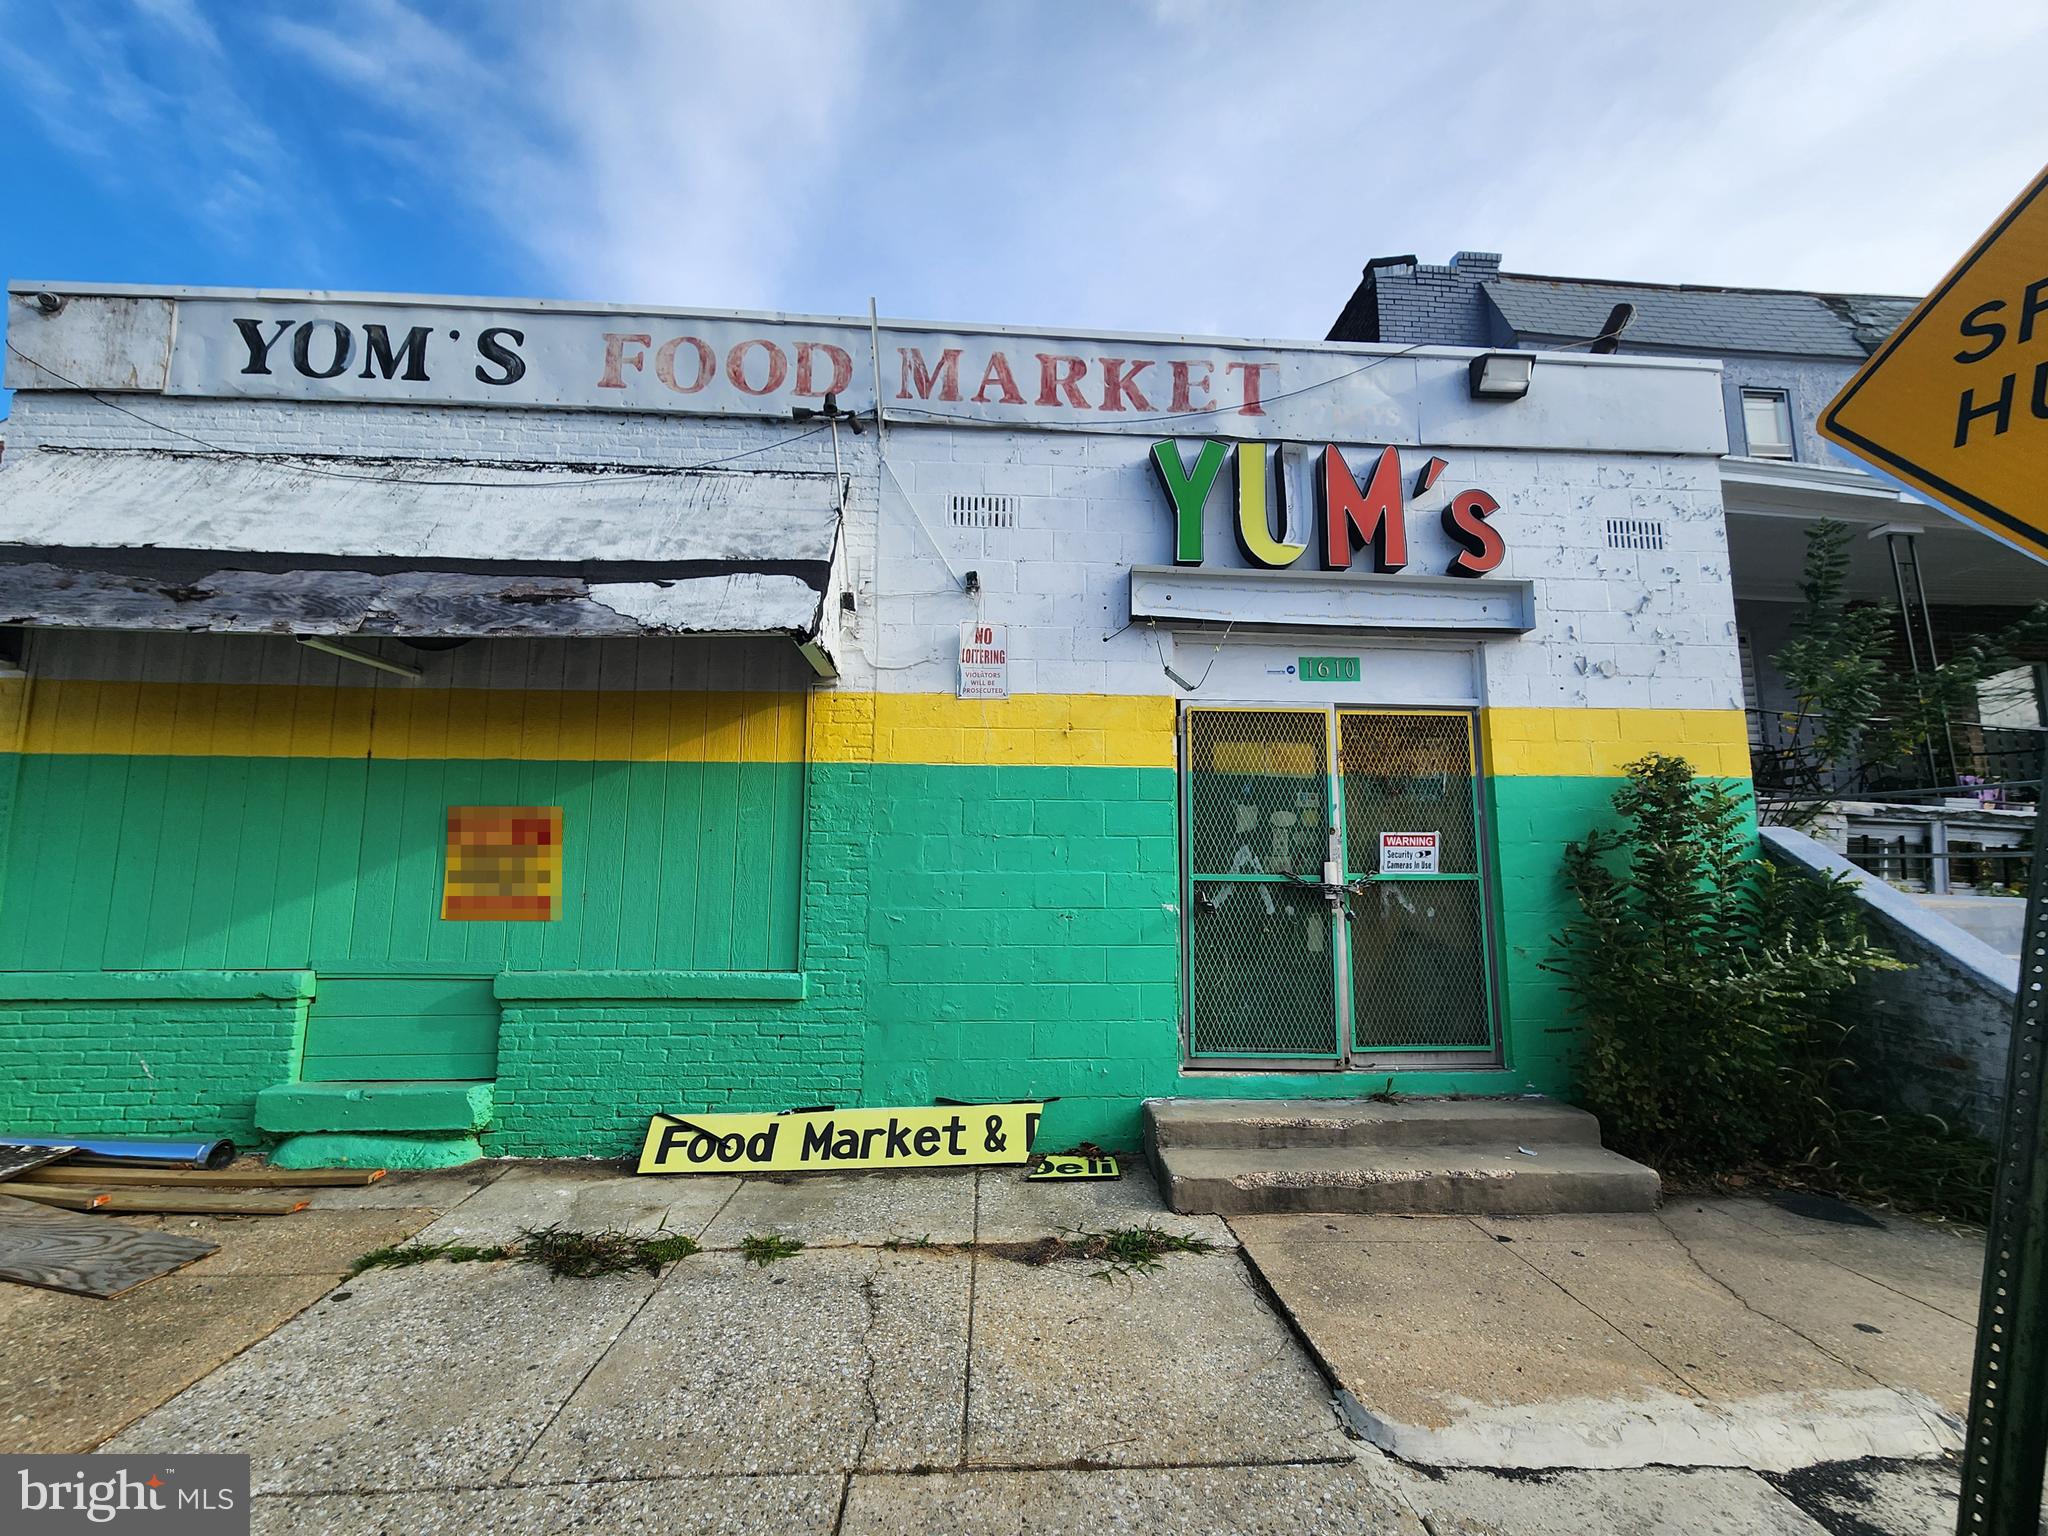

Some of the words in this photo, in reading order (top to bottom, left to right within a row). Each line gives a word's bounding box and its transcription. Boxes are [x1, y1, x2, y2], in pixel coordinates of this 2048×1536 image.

[233, 317, 526, 385] YOM'S
[597, 332, 853, 397] FOOD
[896, 347, 1280, 416] MARKET
[975, 627, 992, 645] NO
[961, 648, 1005, 664] LOITERING
[1307, 658, 1355, 679] 1610
[1386, 836, 1433, 846] WARNING
[1387, 849, 1413, 860] Security
[1386, 860, 1412, 869] Cameras
[1421, 860, 1431, 869] Use
[654, 1122, 780, 1164] Food
[800, 1114, 967, 1161] Market
[983, 1114, 1007, 1153] &
